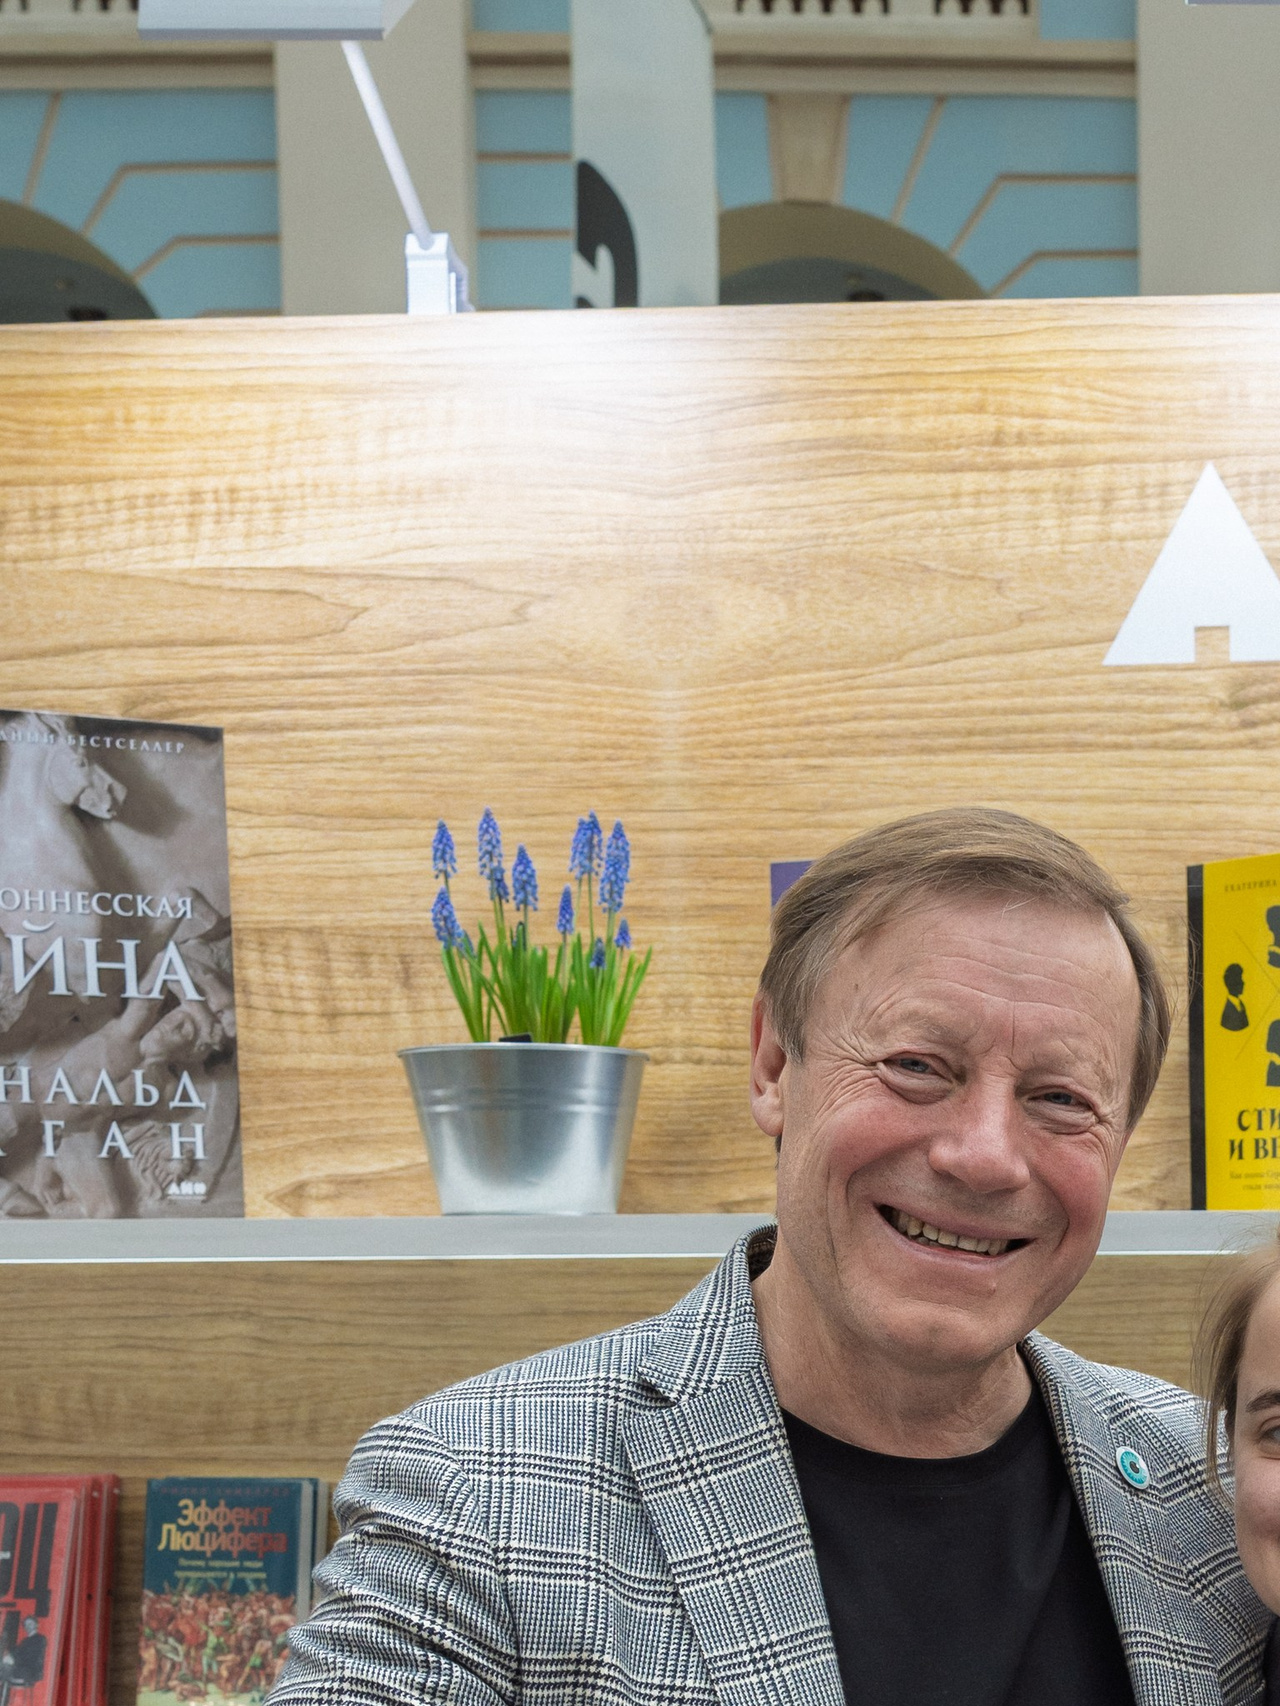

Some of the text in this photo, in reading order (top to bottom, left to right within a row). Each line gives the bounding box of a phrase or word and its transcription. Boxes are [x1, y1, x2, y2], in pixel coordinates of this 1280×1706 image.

[67, 734, 186, 754] БЕСТСЕЛЛЕР
[9, 919, 206, 1001] ЙНА
[0, 1119, 207, 1160] ГАН
[1229, 1138, 1245, 1162] И
[177, 1498, 272, 1532] Эффект
[157, 1523, 287, 1558] Люцифера
